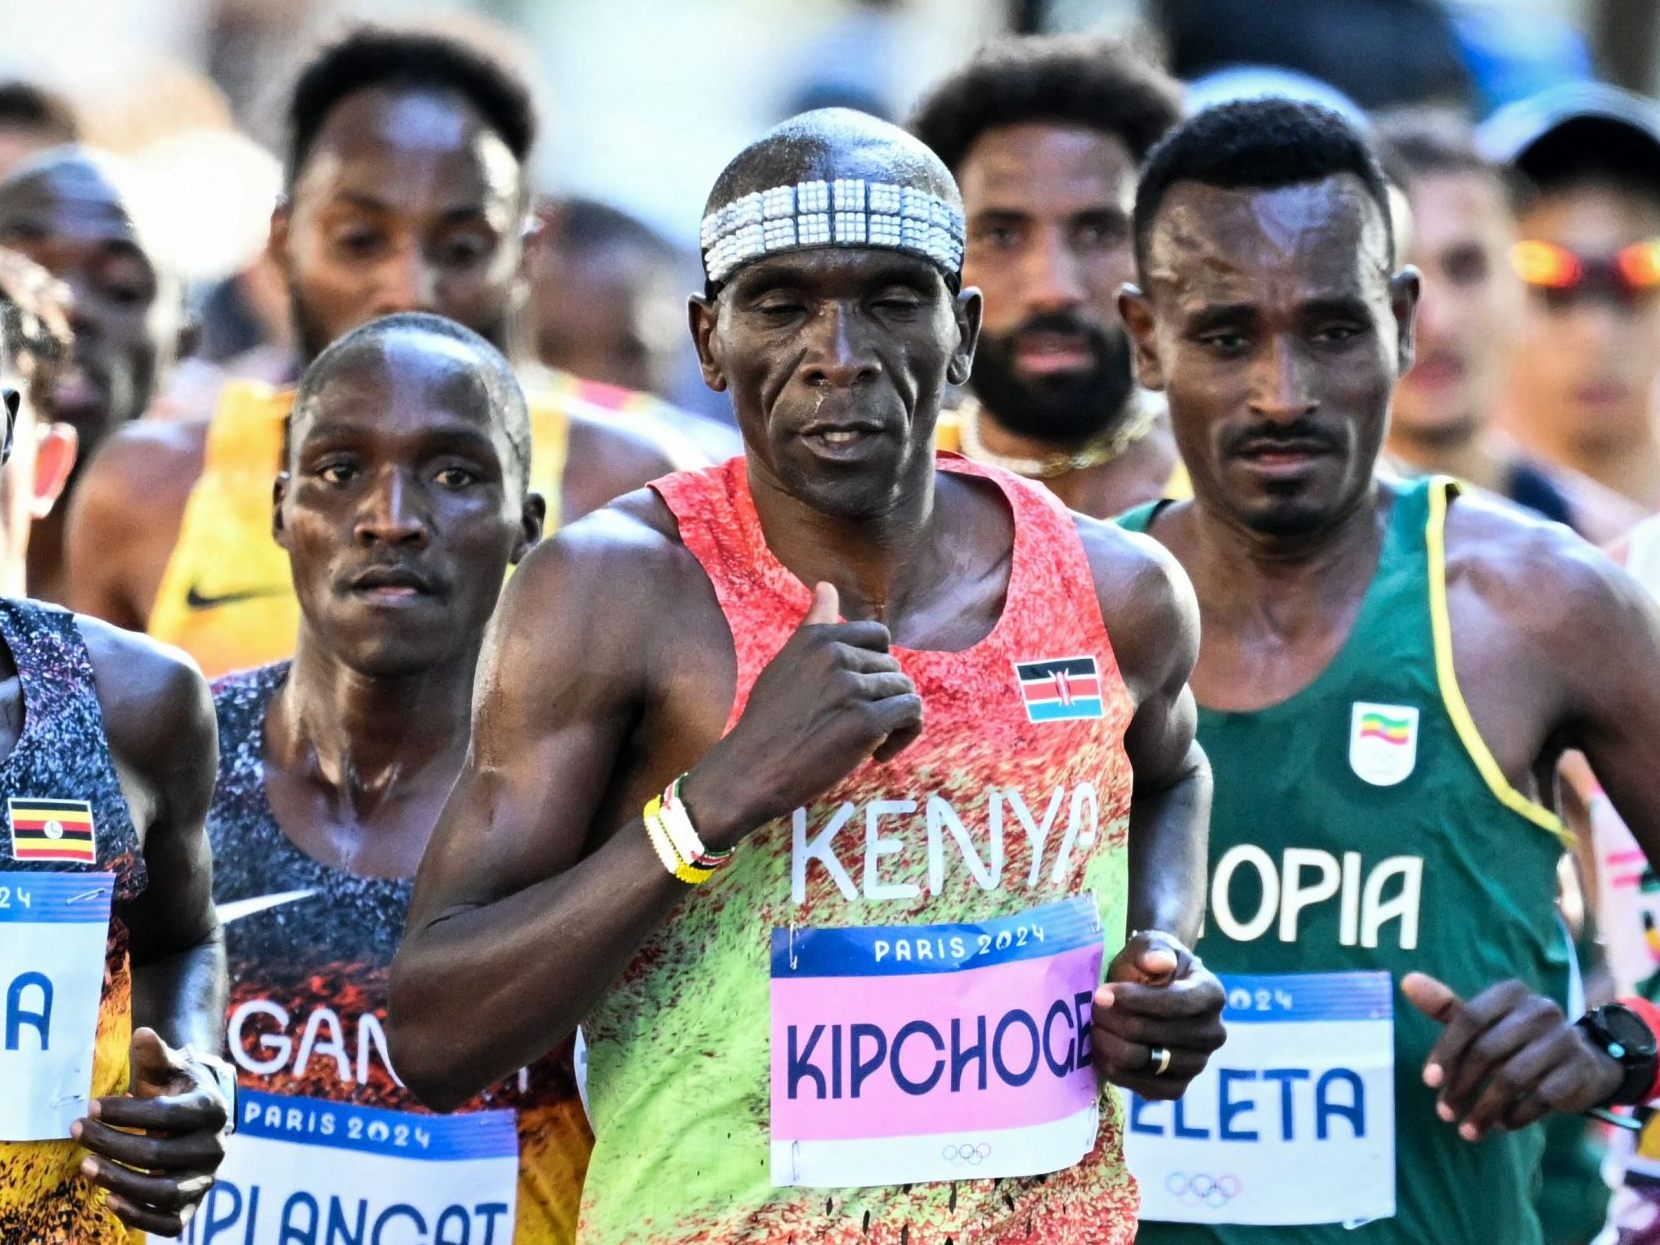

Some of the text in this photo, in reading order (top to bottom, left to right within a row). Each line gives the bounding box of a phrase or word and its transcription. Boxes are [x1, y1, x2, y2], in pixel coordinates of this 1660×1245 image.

[791, 782, 1098, 903] KENYA
[1197, 844, 1424, 950] OPIA
[875, 923, 1045, 962] PARIS 2024
[1228, 988, 1293, 1012] 024
[787, 990, 1093, 1100] KIPCHOGE
[244, 1102, 431, 1149] PARIS 2024
